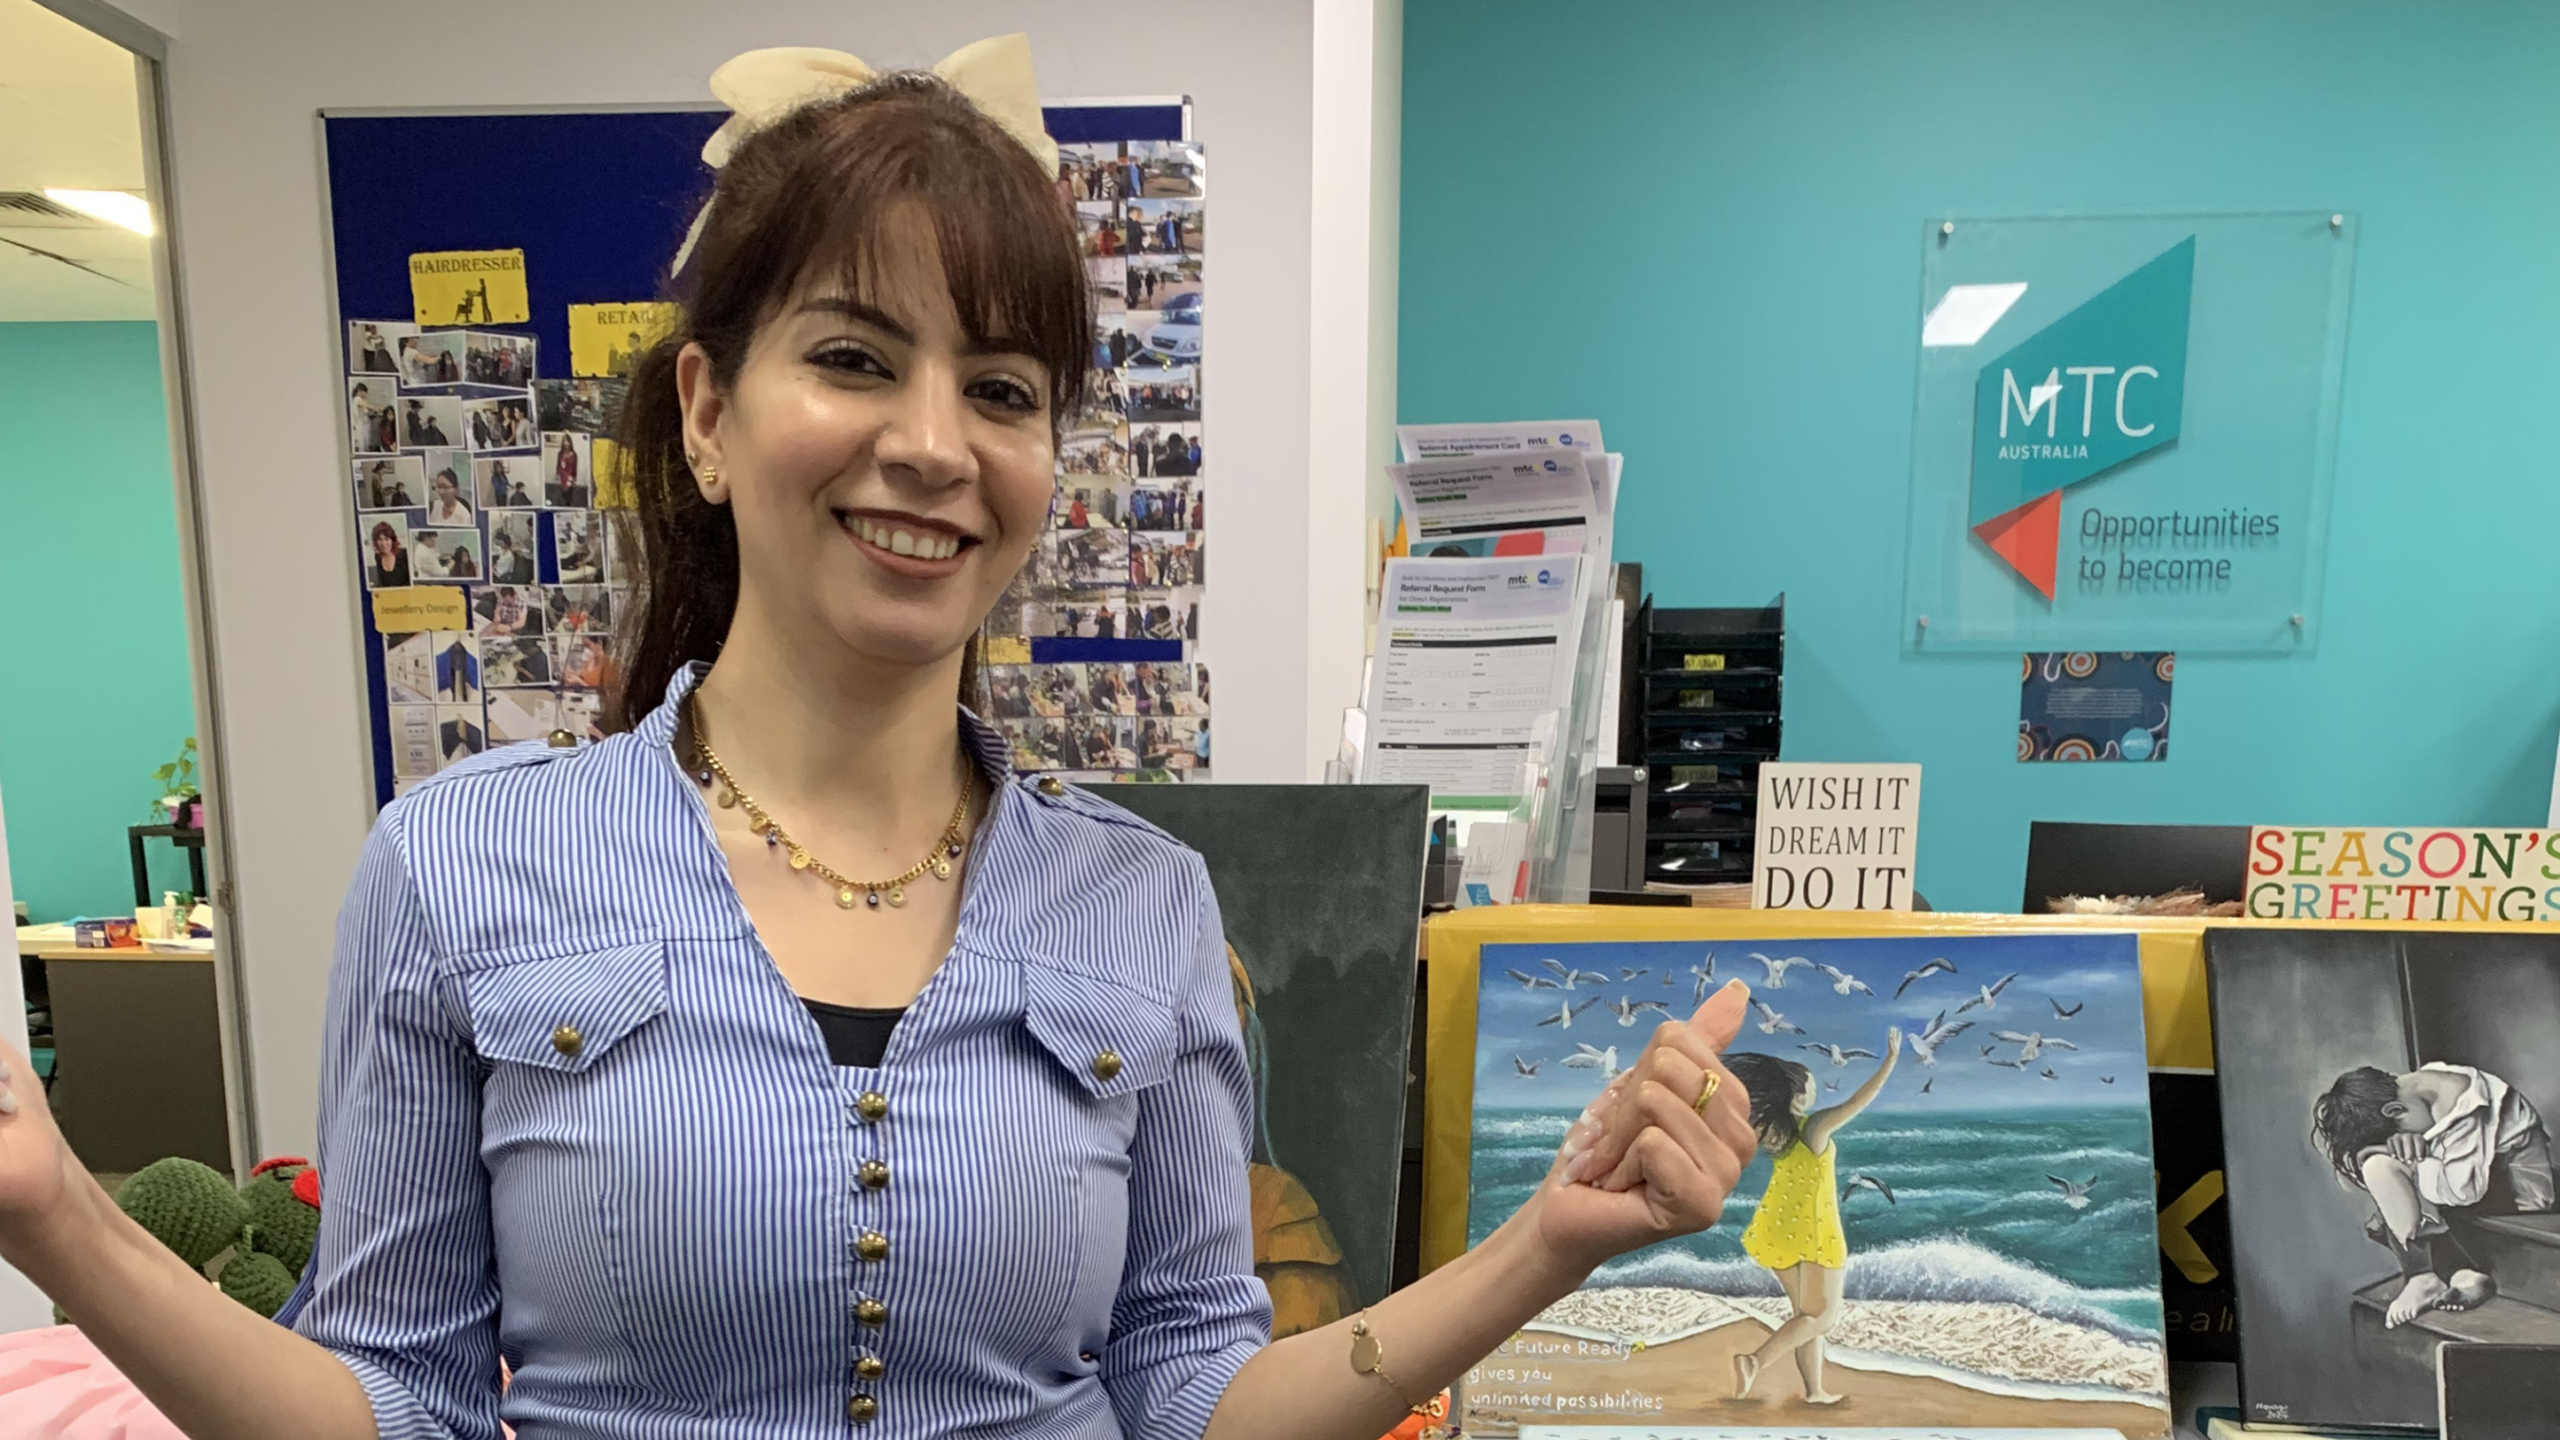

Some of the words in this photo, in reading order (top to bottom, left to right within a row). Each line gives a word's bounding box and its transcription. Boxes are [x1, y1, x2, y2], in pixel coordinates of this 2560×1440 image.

[414, 255, 522, 275] HAIRDRESSER
[1999, 366, 2160, 438] MTC
[1501, 442, 1520, 450] Card
[1527, 436, 1549, 446] mtc
[1998, 444, 2089, 460] AUSTRALIA
[1513, 464, 1534, 474] mtc
[2081, 507, 2280, 545] Opportunities
[2079, 555, 2106, 581] to
[2119, 552, 2231, 581] become
[1400, 584, 1431, 592] Referral
[1433, 584, 1464, 594] Request
[1466, 584, 1486, 592] Form
[1508, 575, 1528, 584] mtc
[380, 603, 424, 617] Jewellery
[426, 602, 460, 615] Design
[1771, 777, 1863, 811] WISH
[1874, 777, 1909, 811] IT
[1769, 826, 1867, 856] DREAM
[1878, 826, 1905, 855] IT
[1764, 866, 1834, 910] DO
[1855, 868, 1906, 910] IT
[1516, 1340, 1571, 1356] Future
[1579, 1339, 1632, 1361] Ready
[1469, 1366, 1515, 1384] gives
[1522, 1366, 1552, 1384] you
[1470, 1390, 1552, 1408] unlimited
[1556, 1389, 1664, 1412] possibilities
